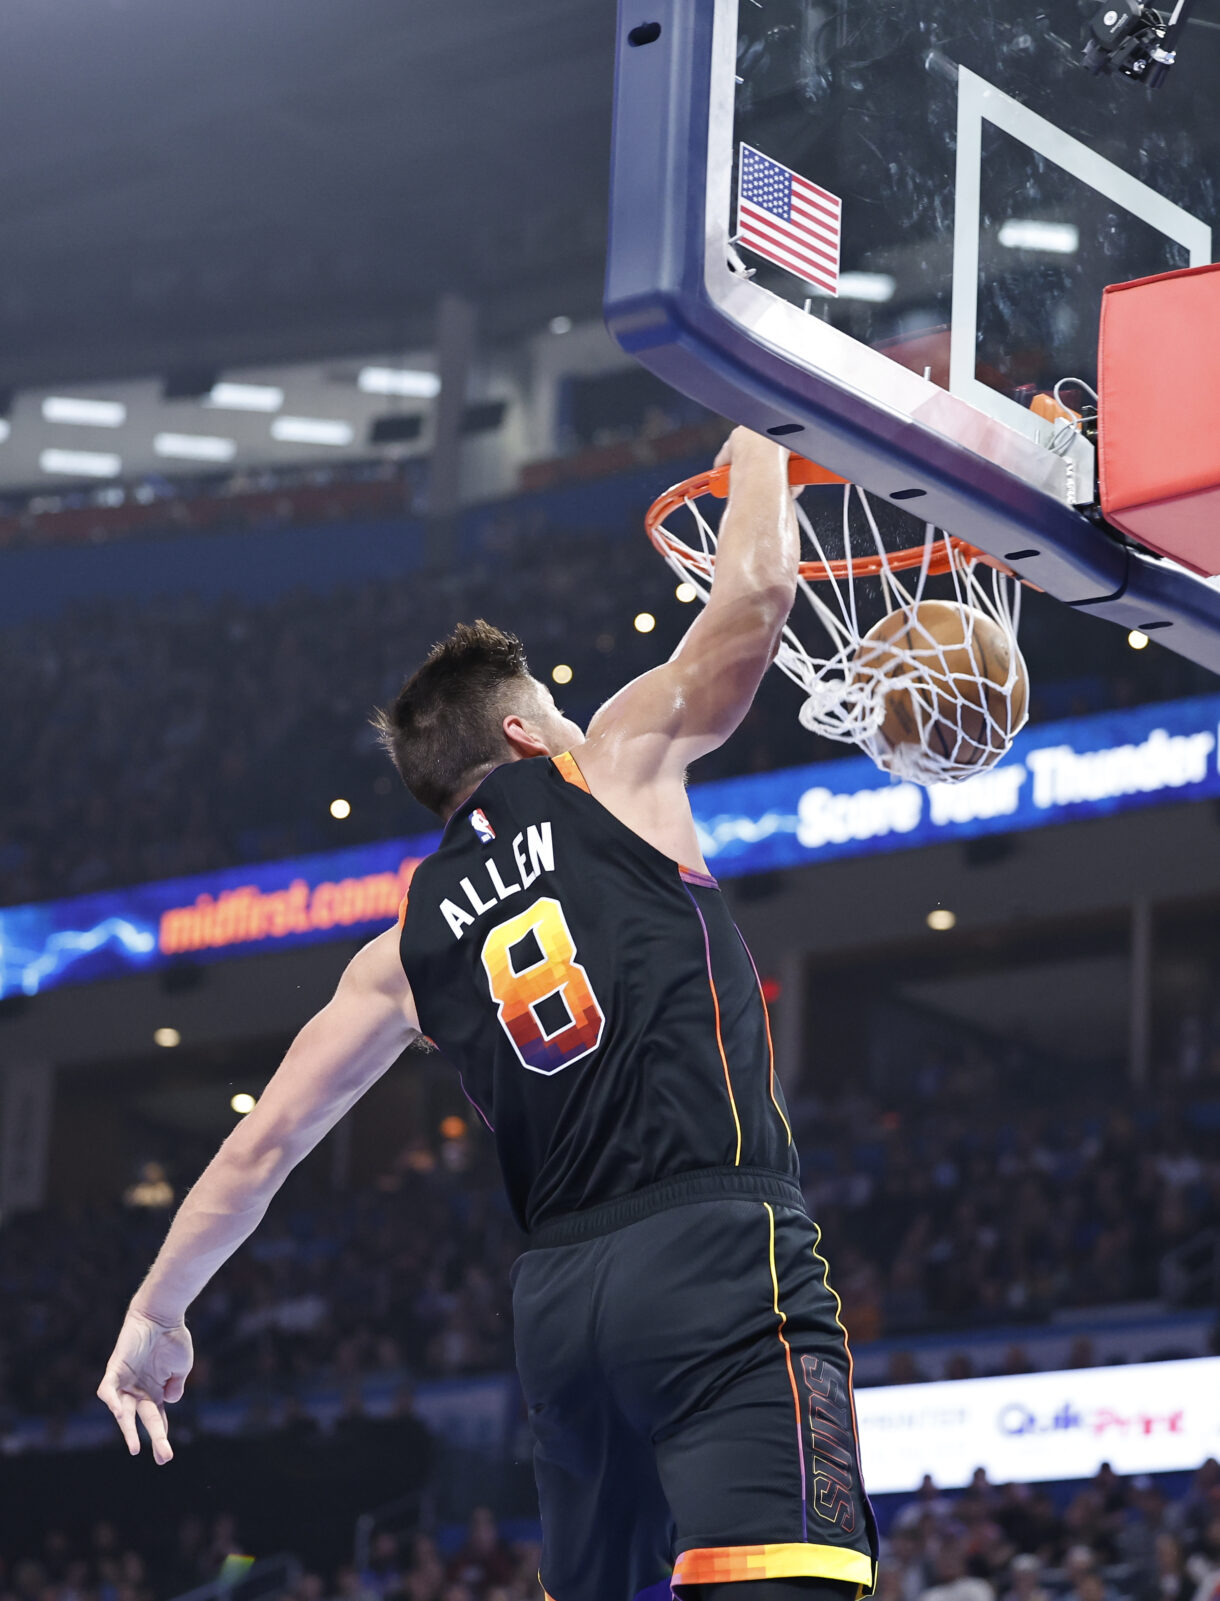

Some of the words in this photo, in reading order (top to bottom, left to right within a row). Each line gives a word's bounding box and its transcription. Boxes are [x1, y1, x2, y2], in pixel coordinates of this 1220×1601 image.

[797, 784, 922, 848] Score
[1027, 728, 1215, 808] Thunder
[439, 821, 555, 940] ALLEN
[481, 896, 606, 1076] 8
[801, 1355, 855, 1533] SUNS
